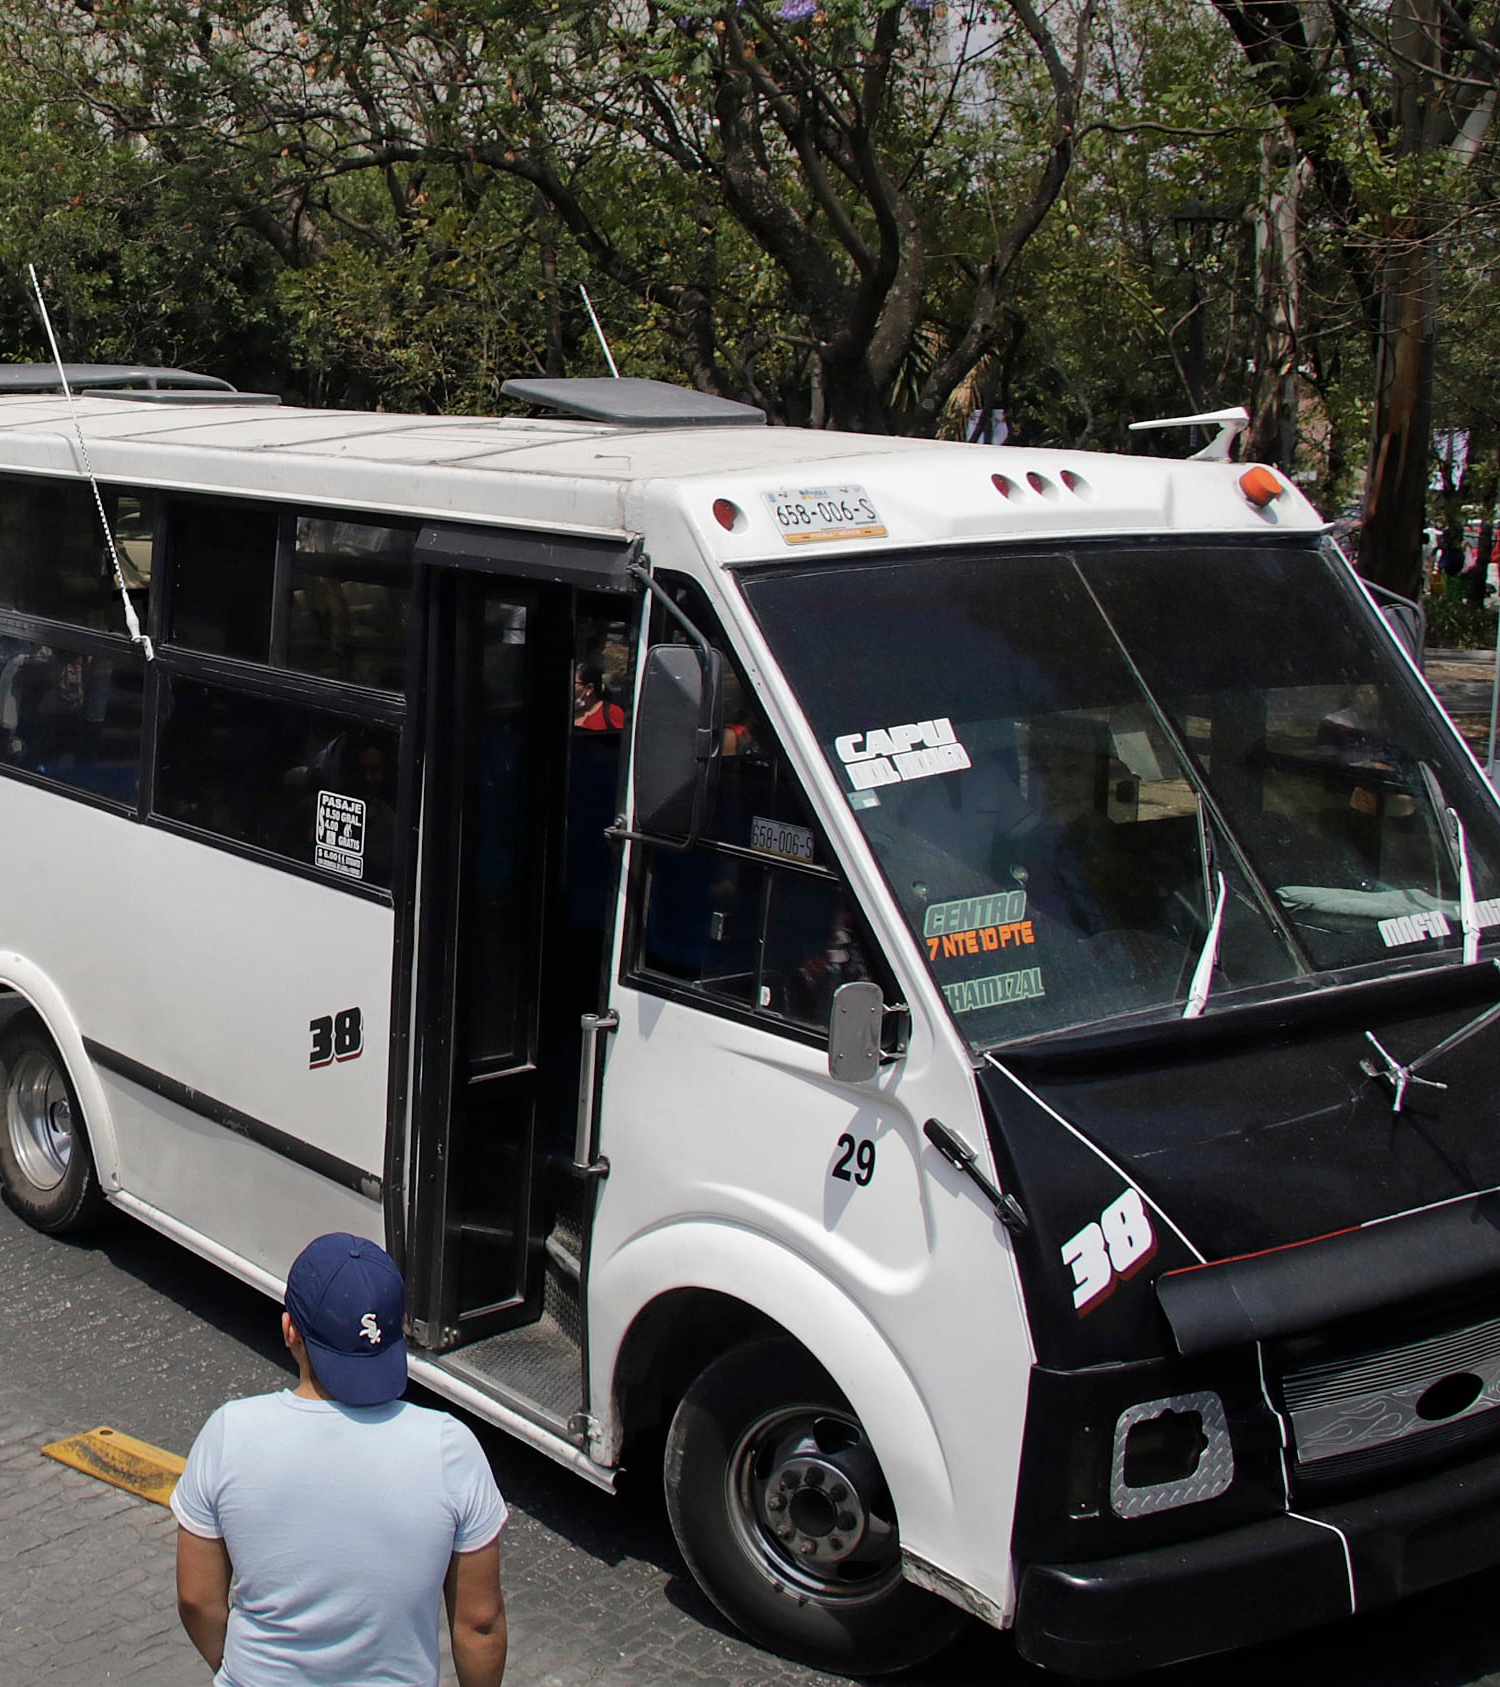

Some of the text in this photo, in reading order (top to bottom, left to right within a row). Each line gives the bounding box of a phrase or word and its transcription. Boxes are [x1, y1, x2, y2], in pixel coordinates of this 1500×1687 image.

[776, 498, 876, 526] 658-006-S
[835, 718, 957, 763] CAPU
[322, 795, 362, 814] PASAJE
[341, 813, 362, 827] GRAL.
[324, 820, 339, 832] 4.00
[338, 836, 360, 851] GRATIS
[752, 824, 813, 858] 658-006-S
[923, 889, 1027, 938] CENTRO
[926, 920, 1035, 961] 7 NTE 10 PTE
[309, 1006, 364, 1070] 38
[832, 1133, 876, 1187] 29
[1060, 1187, 1158, 1318] 38
